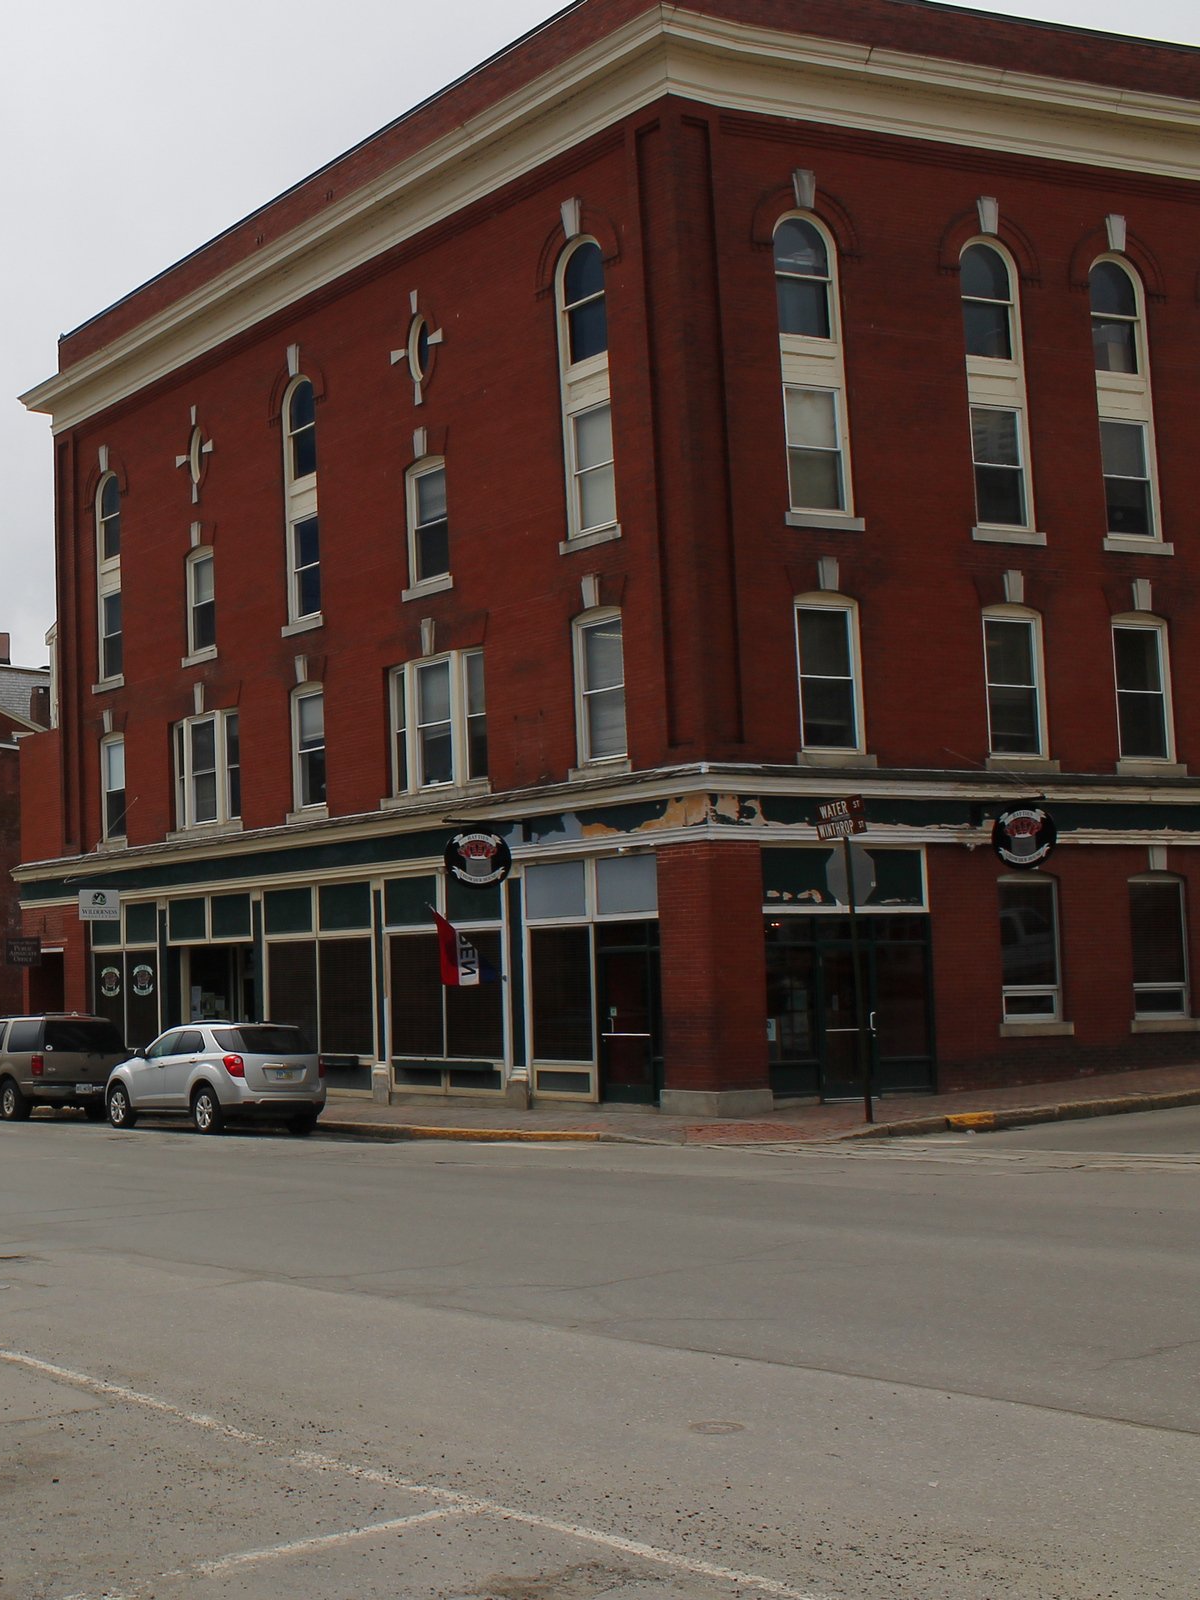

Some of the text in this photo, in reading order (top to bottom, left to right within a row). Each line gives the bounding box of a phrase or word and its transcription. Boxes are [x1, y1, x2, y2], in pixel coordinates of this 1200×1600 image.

[819, 800, 860, 819] WATER ST
[817, 820, 865, 838] WINTHROP ST
